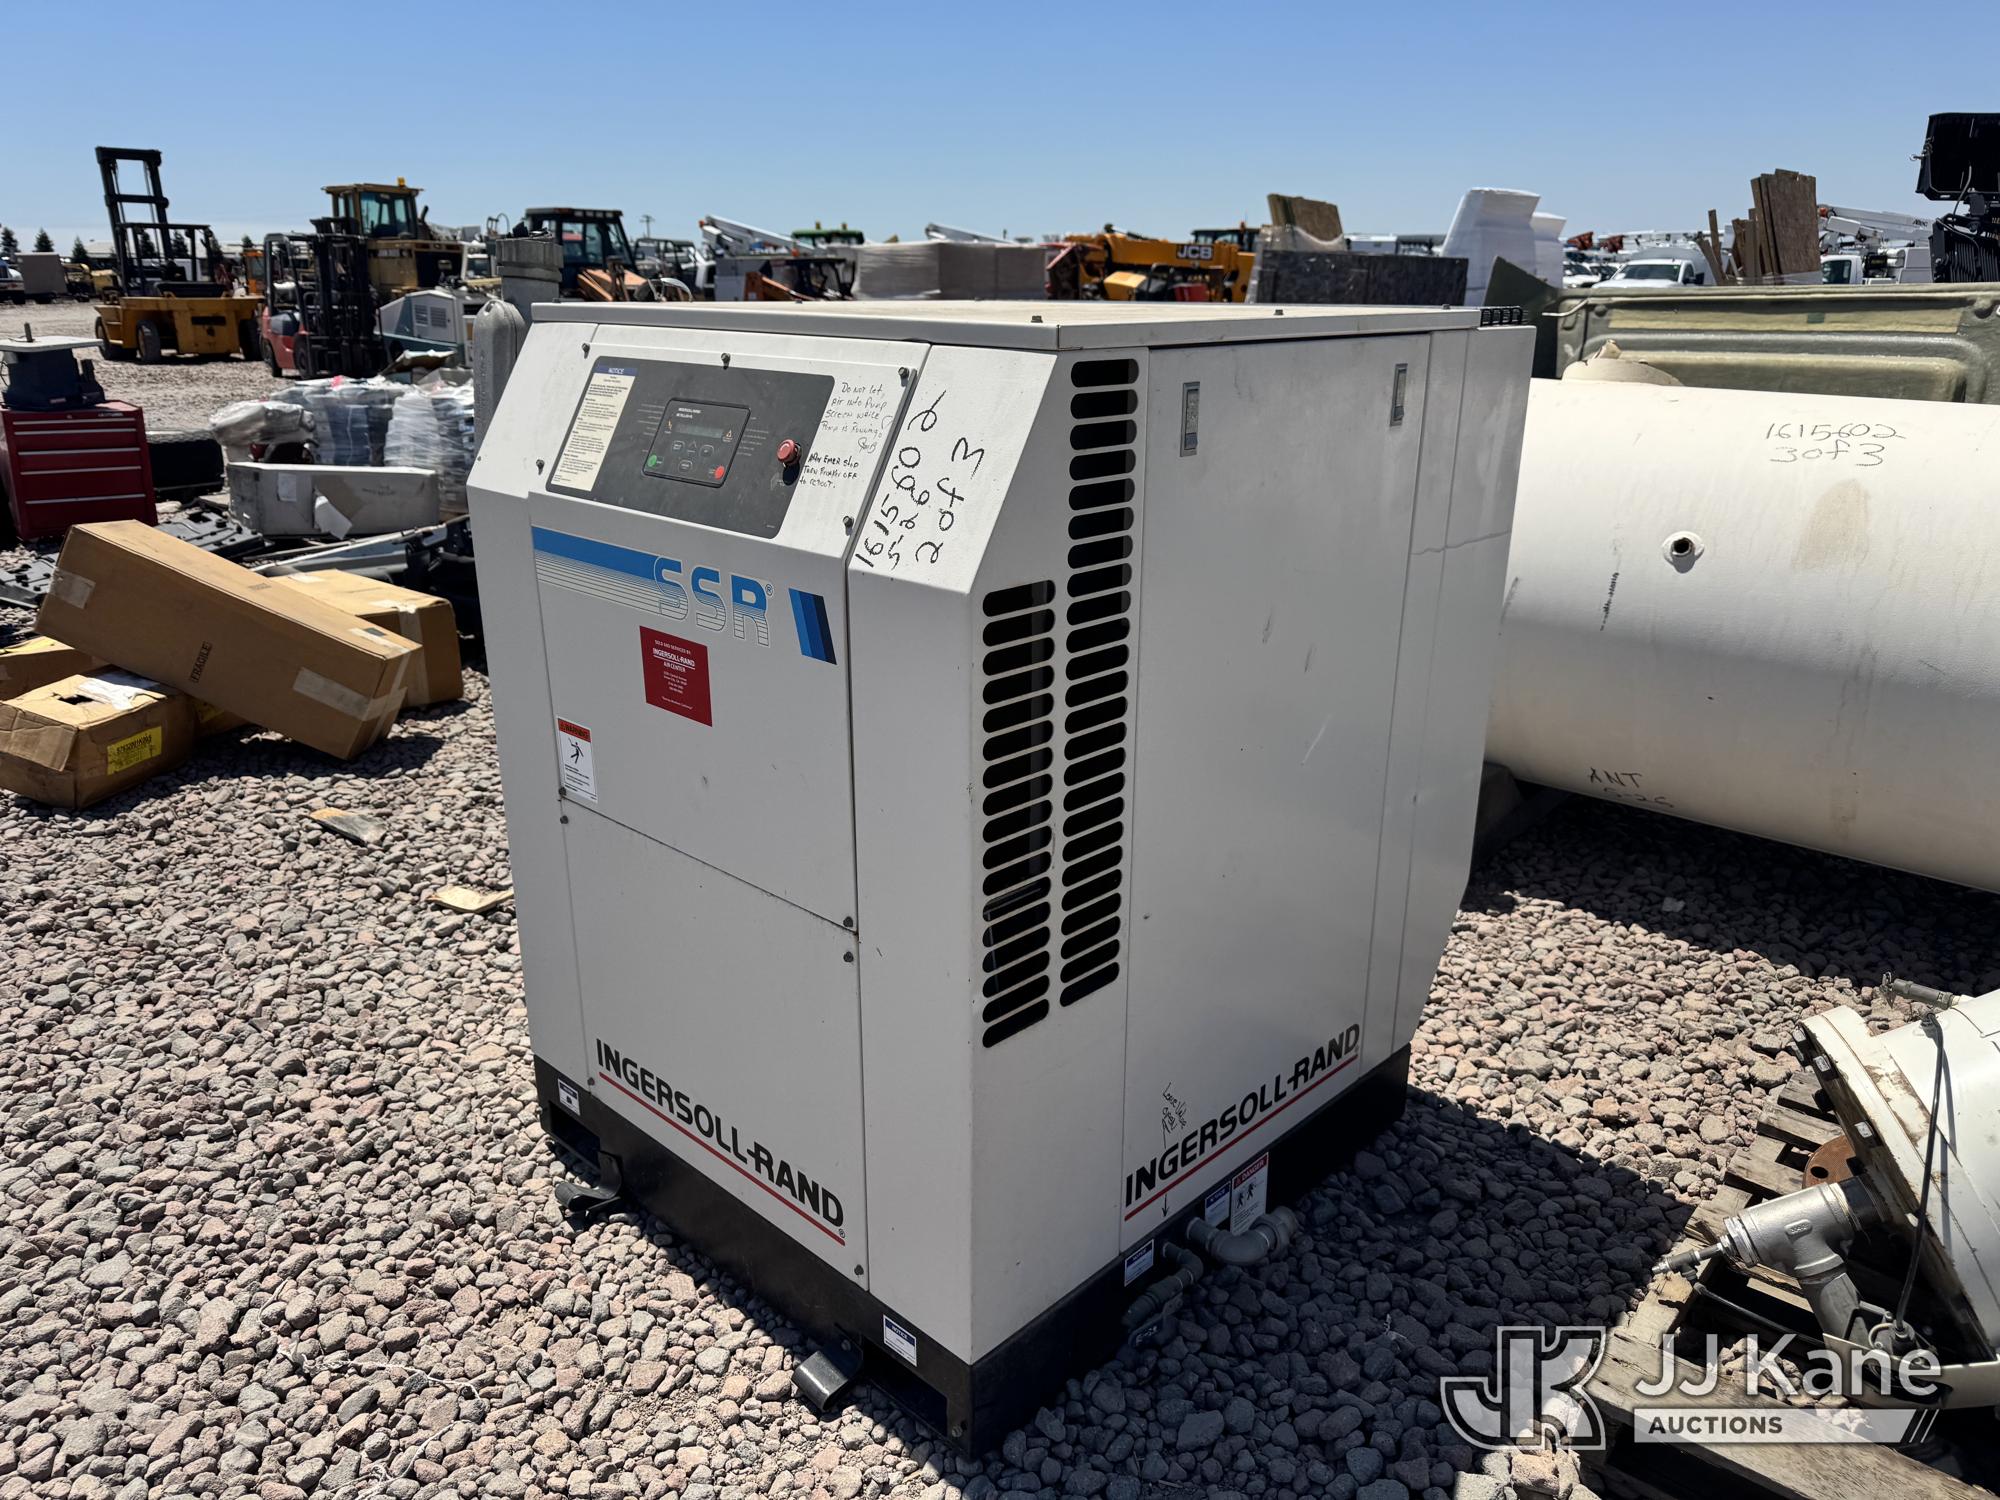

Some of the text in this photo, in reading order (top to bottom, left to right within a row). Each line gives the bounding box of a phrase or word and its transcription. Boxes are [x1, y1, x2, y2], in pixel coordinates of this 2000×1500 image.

[1177, 245, 1212, 260] JCB
[1765, 422, 1907, 440] 1615602
[654, 555, 770, 648] SSR
[190, 640, 211, 682] FRAGILE
[596, 1038, 844, 1228] INGERSOLL-RAND
[1125, 1023, 1360, 1209] INGERSOLL-RAND
[1241, 1159, 1265, 1180] DANGER
